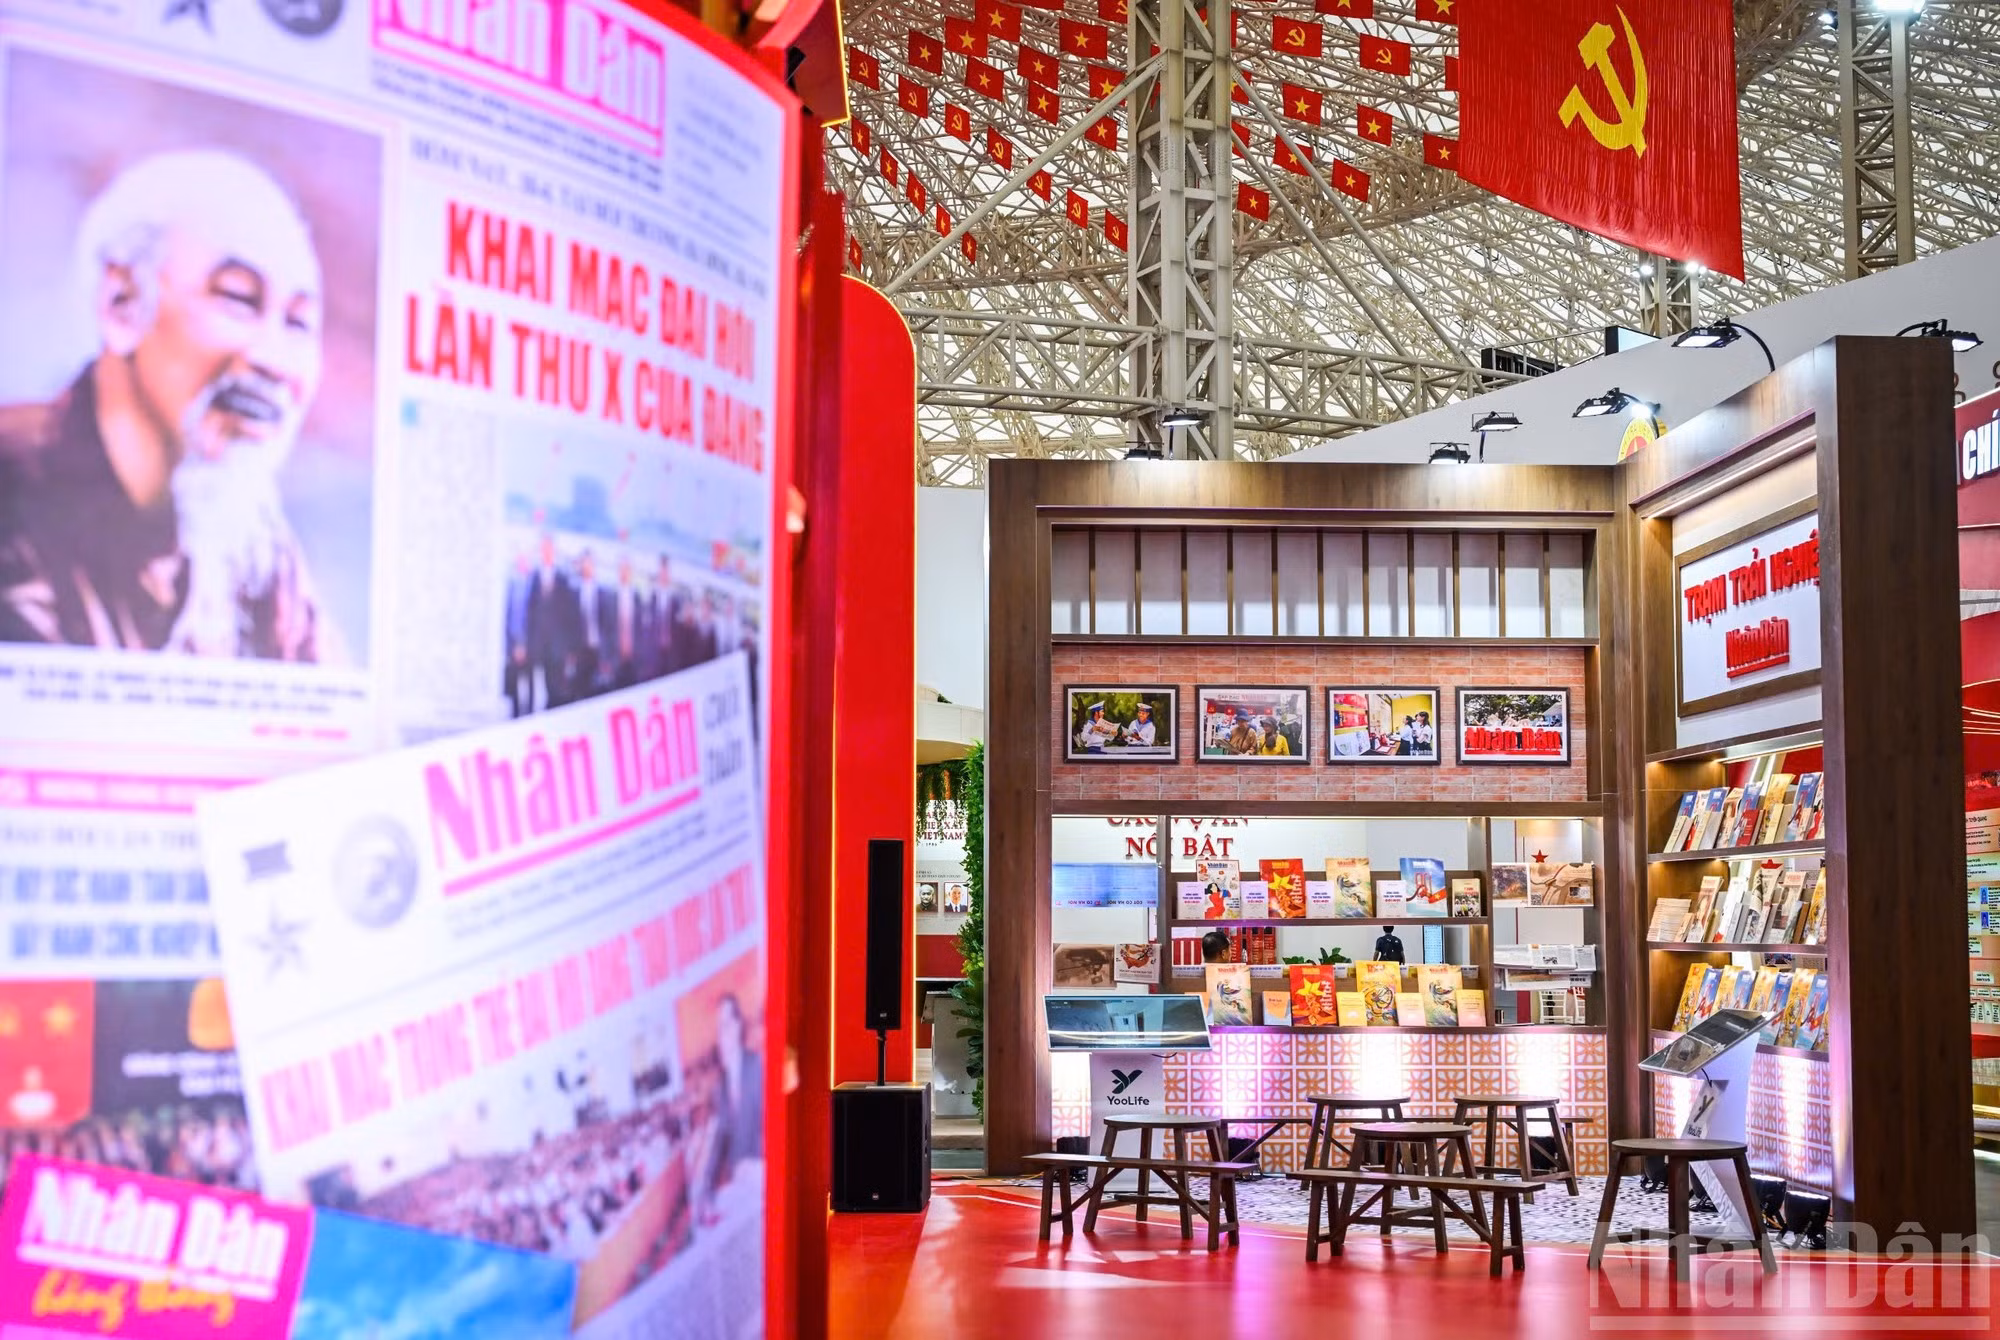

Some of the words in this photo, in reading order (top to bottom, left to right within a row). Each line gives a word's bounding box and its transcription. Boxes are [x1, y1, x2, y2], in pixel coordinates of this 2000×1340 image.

[445, 200, 554, 305] KHAI
[602, 349, 624, 424] X
[1684, 574, 1728, 624] TRẠM
[1729, 548, 1767, 606] TRẢI
[1465, 727, 1517, 750] Nhân
[1522, 727, 1561, 749] Dân
[423, 733, 599, 871] Nhân
[608, 696, 699, 807] Dân
[1107, 1096, 1150, 1106] YooLife
[19, 1165, 180, 1262] Nhân
[181, 1194, 289, 1280] Dân
